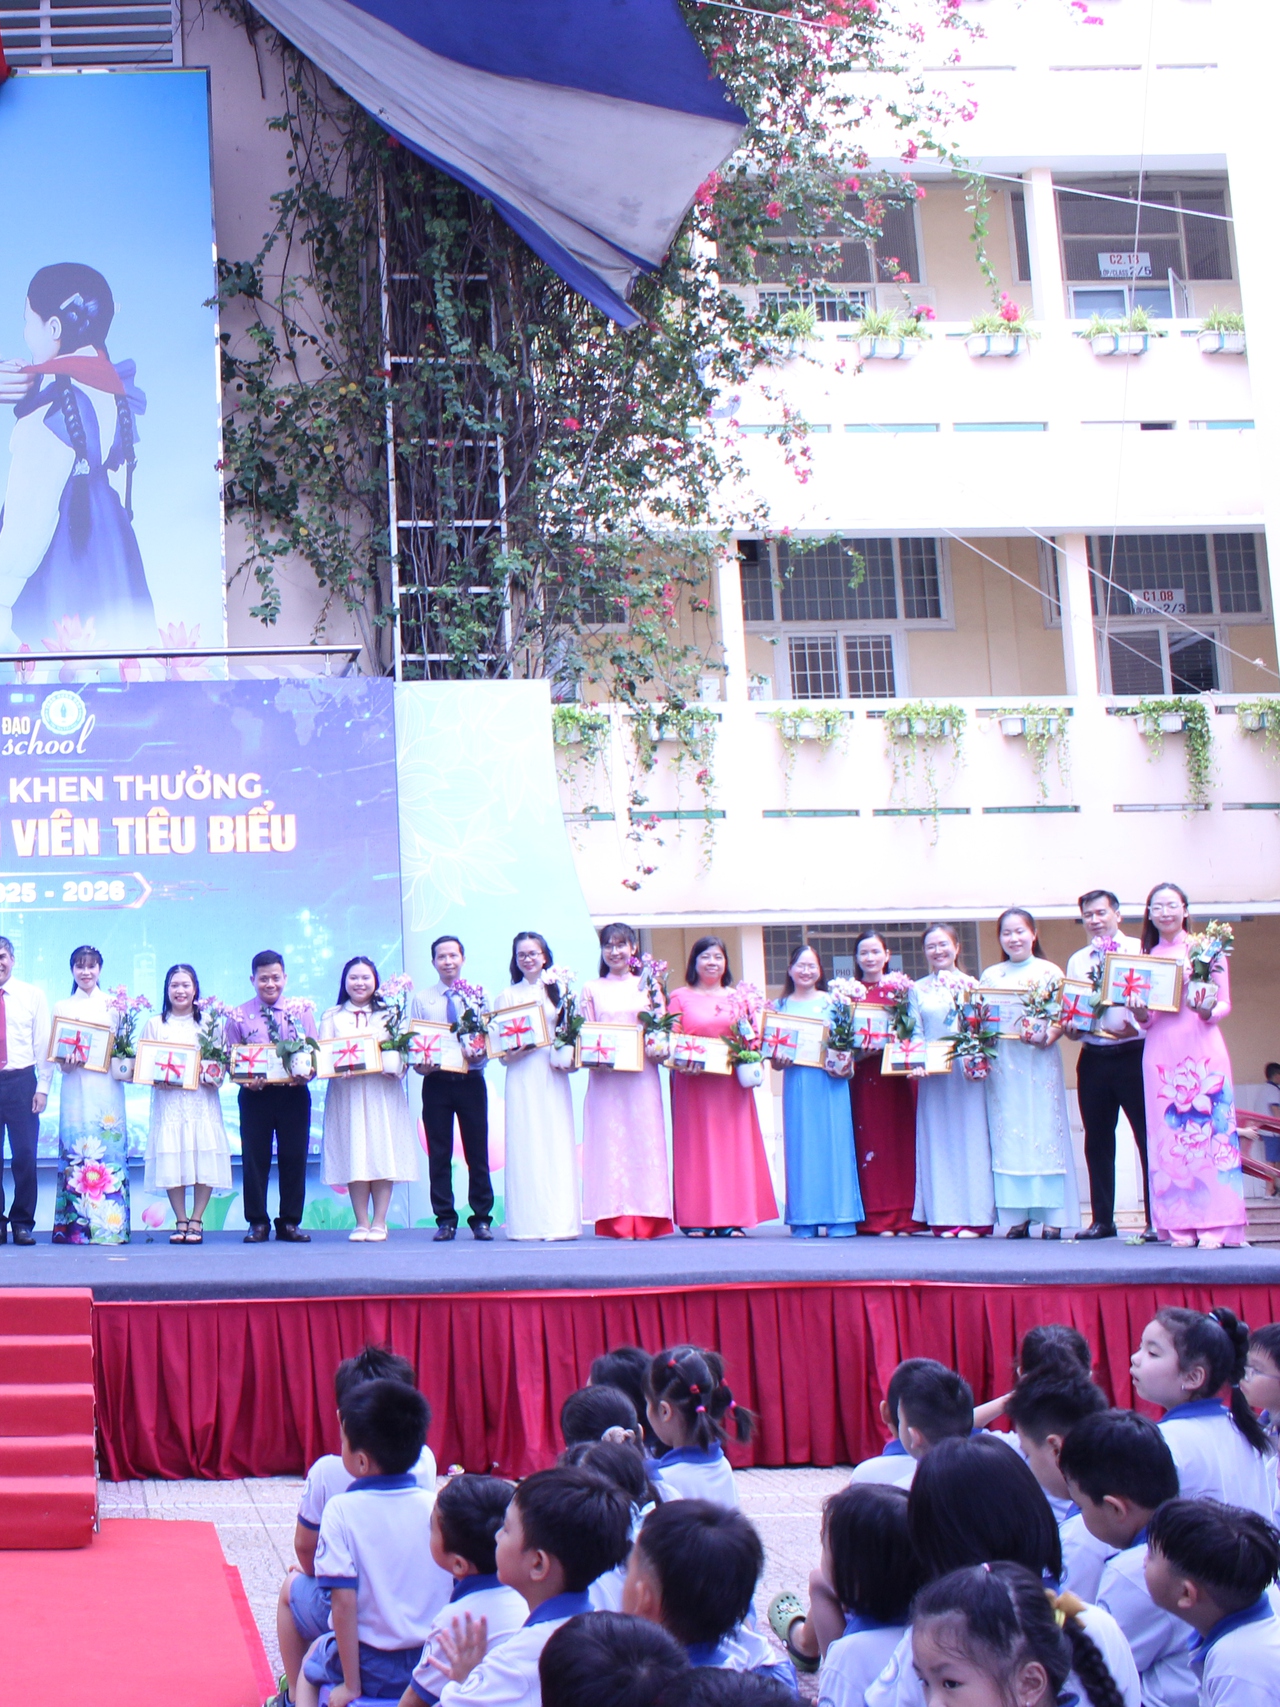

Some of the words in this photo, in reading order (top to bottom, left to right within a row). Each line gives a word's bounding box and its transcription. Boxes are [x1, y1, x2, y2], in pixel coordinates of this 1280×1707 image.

[1109, 254, 1140, 265] C2.13
[1143, 590, 1174, 602] C1.08
[1163, 603, 1186, 613] 2/3
[2, 716, 31, 737] ĐẠO
[2, 714, 96, 755] school
[9, 775, 104, 804] KHEN
[113, 764, 263, 801] THƯỞNG
[11, 808, 100, 857] VIÊN
[112, 806, 197, 856] TIÊU
[208, 800, 297, 854] BIỂU
[62, 880, 126, 903] 2026
